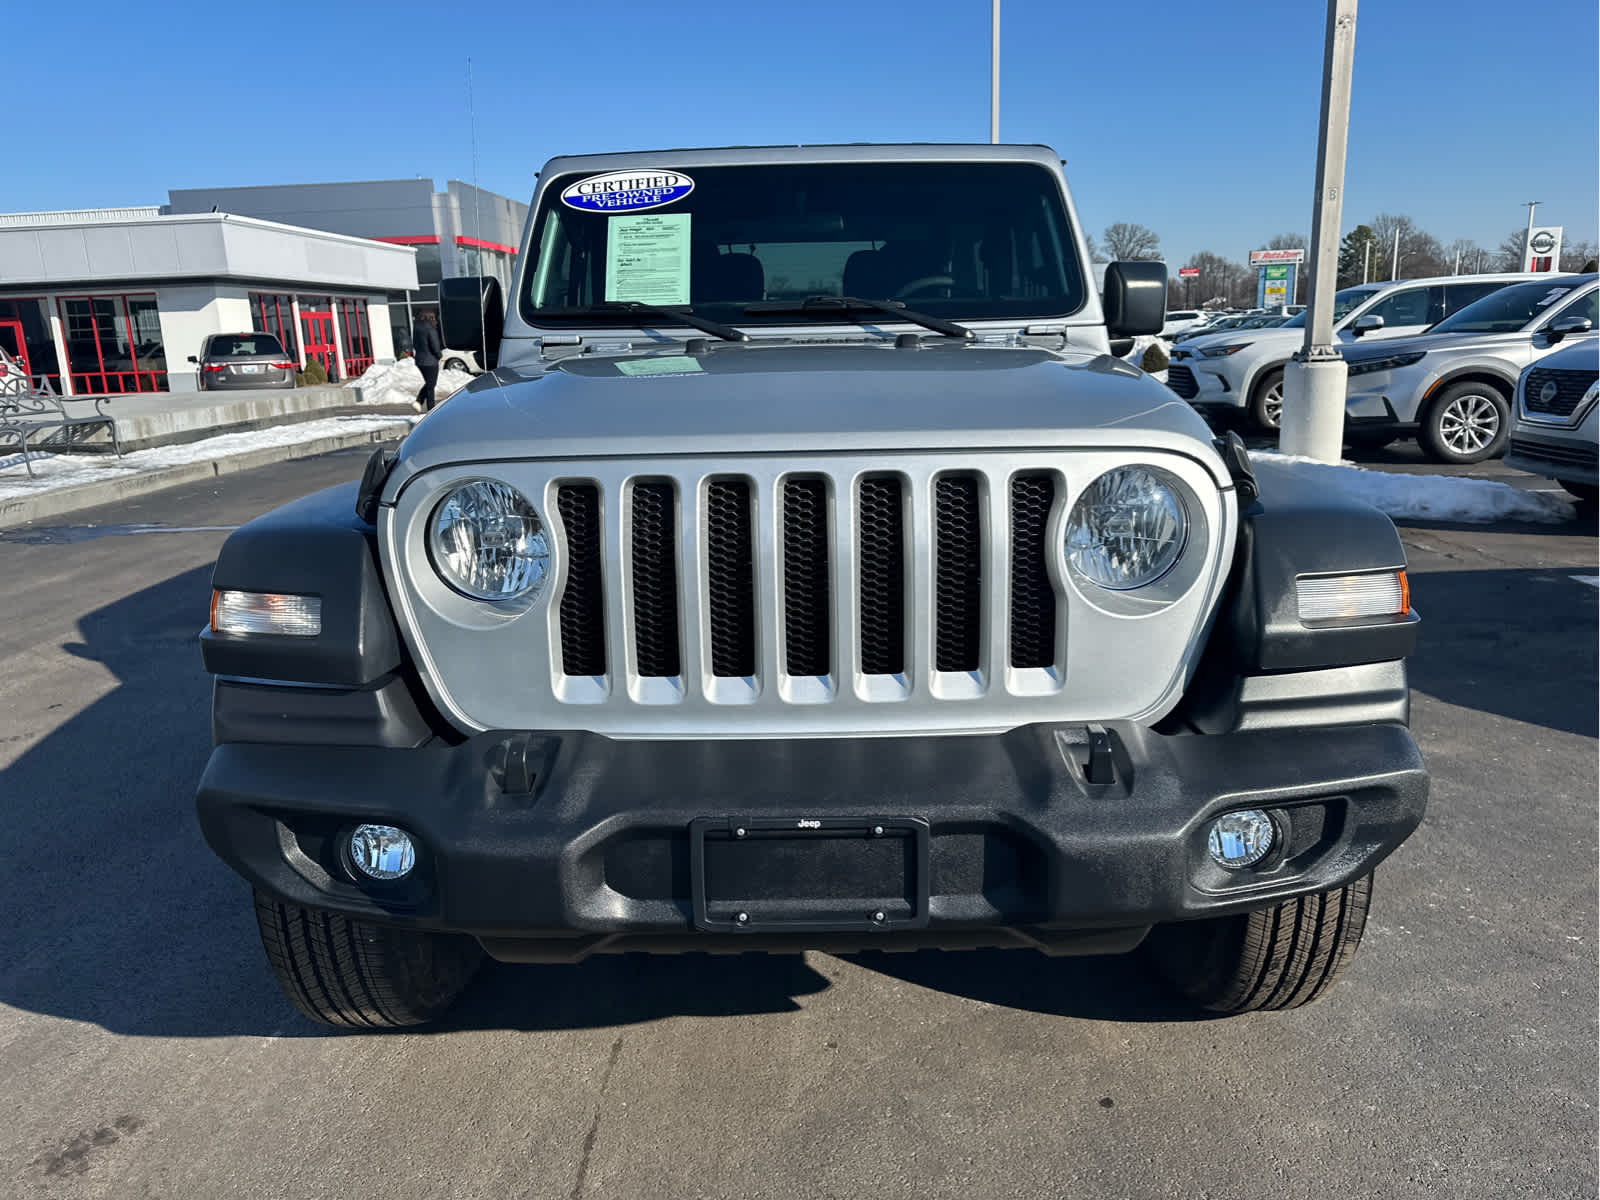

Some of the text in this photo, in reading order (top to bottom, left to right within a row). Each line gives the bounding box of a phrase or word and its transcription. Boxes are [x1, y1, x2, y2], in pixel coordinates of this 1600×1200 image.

[577, 175, 679, 195] CERTIFIED
[582, 187, 674, 203] PRE-OWNED
[595, 195, 661, 208] VEHICLE
[797, 818, 821, 829] Jeep
